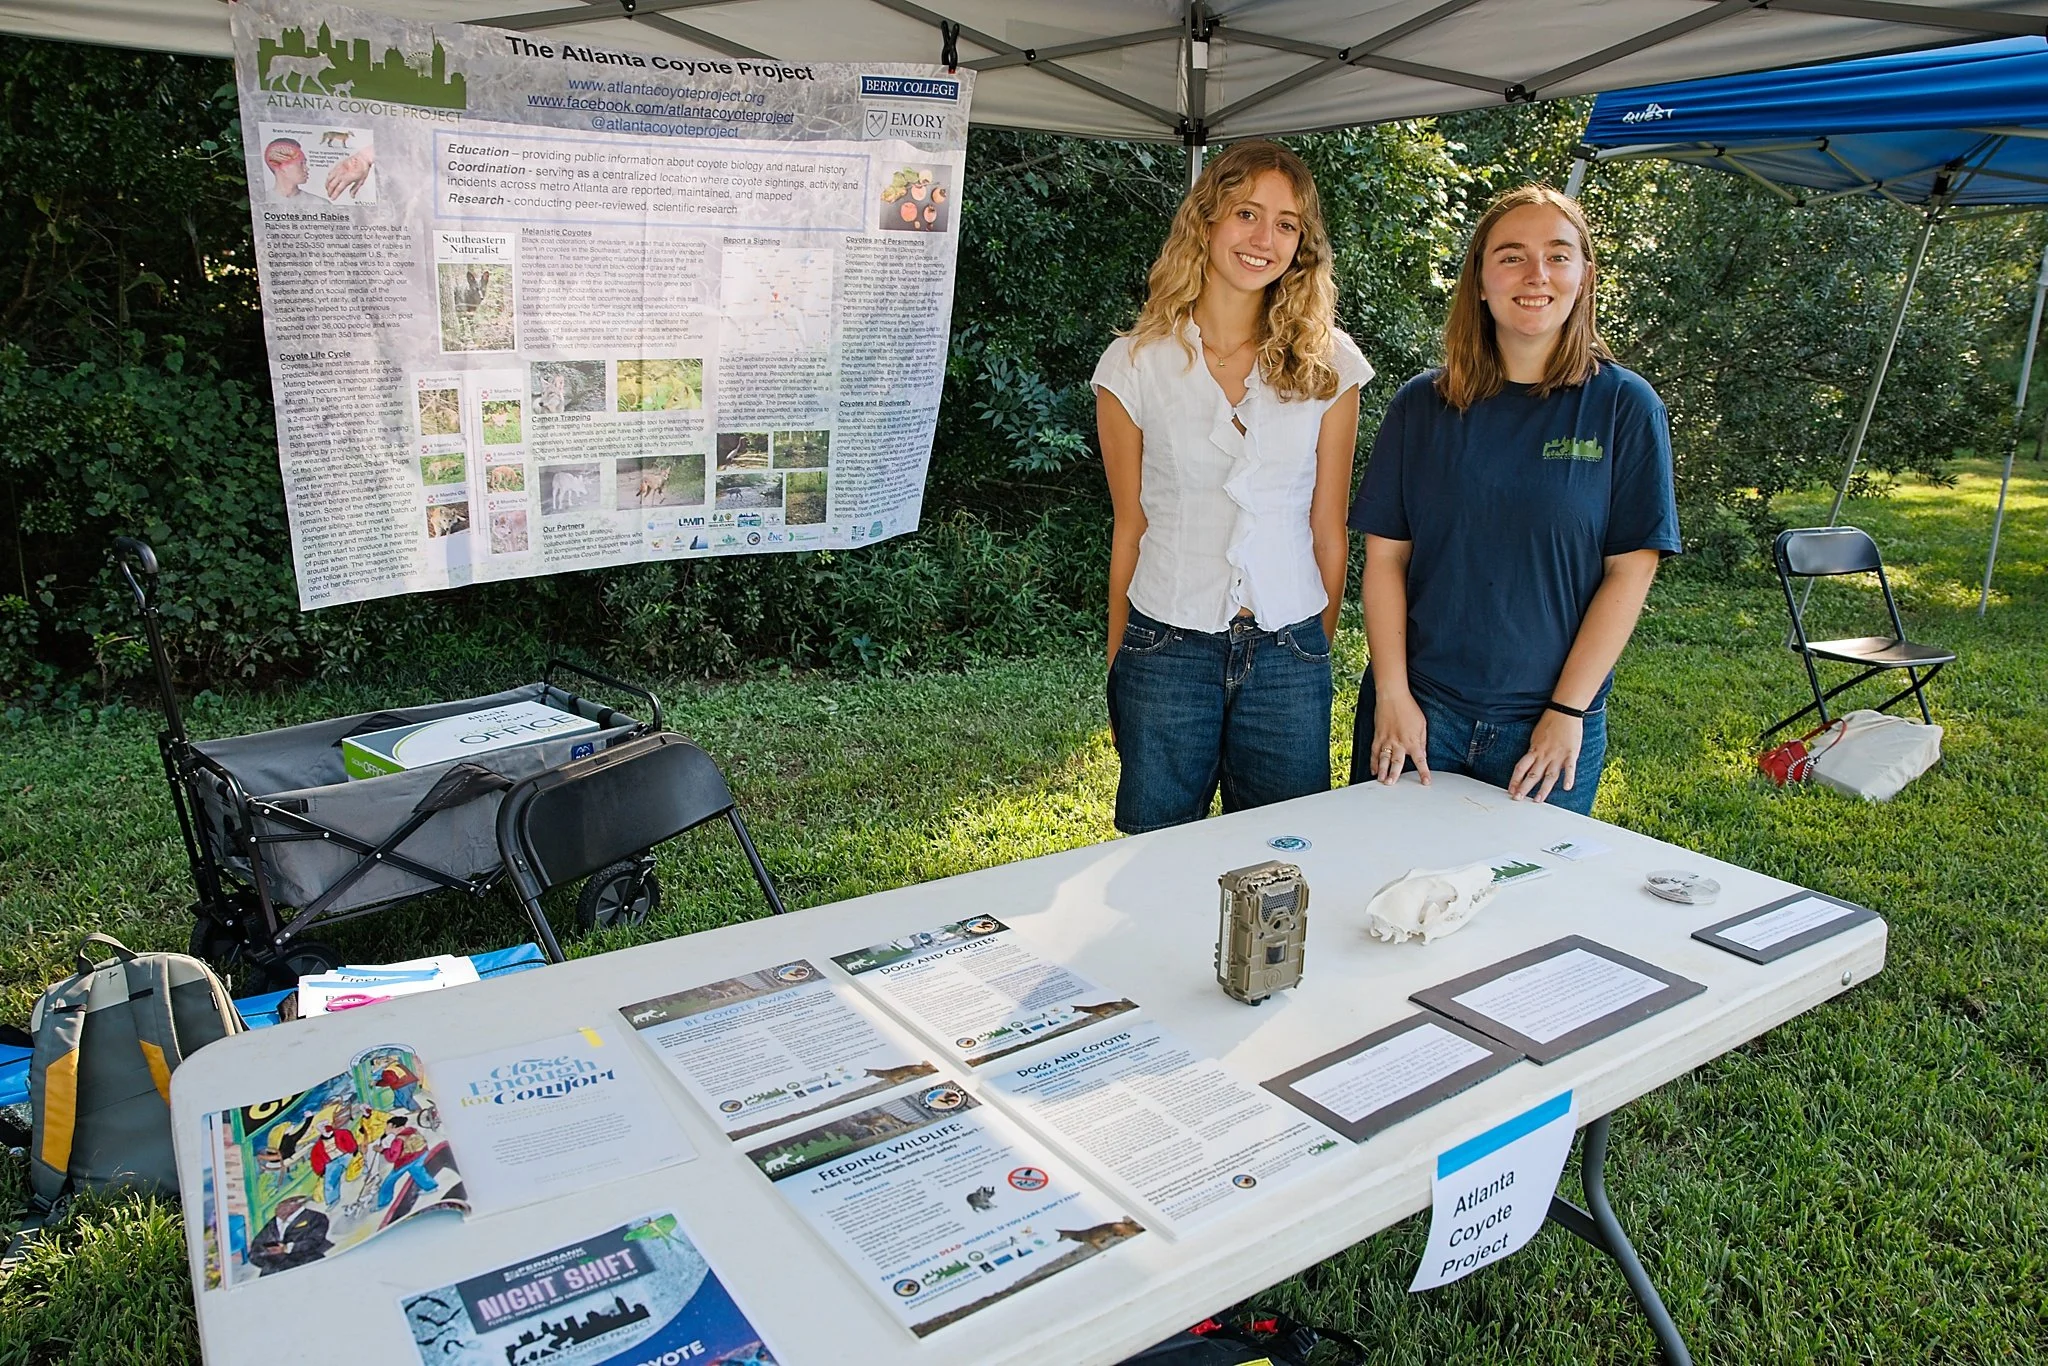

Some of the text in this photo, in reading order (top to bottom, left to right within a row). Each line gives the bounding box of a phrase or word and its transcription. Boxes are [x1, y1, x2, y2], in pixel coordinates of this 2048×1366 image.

[506, 36, 815, 82] The Atlanta Coyote Project
[567, 78, 765, 106] www.atlantacoyoteproject.org
[866, 79, 955, 96] BERRY COLLEGE
[267, 94, 463, 123] ATLANTA COYOTE PROJECT
[527, 94, 795, 125] www.facebook.com/atlantacoyoteproject
[891, 112, 945, 129] EMORY
[1622, 108, 1676, 124] QUEST
[591, 116, 739, 138] @atlantacoyoteproject
[889, 128, 943, 140] UNIVERSITY
[447, 143, 509, 157] Education
[522, 150, 571, 163] providing
[574, 152, 606, 164] public
[608, 154, 664, 167] information
[667, 156, 694, 168] about
[697, 160, 728, 171] coyote
[731, 160, 763, 172] biology
[766, 162, 783, 172] and
[786, 163, 815, 173] natural
[818, 164, 847, 176] history
[447, 176, 793, 202] incidents across metro Atlanta are reported, maintained, and mapped
[448, 161, 525, 175] Coordination
[535, 167, 574, 179] serving
[577, 170, 590, 178] as
[593, 171, 599, 179] a
[602, 169, 657, 181] centralized
[660, 173, 697, 183] location
[700, 175, 729, 185] where
[731, 177, 762, 188] coyote
[765, 177, 807, 190] sightings,
[809, 179, 840, 191] activity,
[843, 180, 859, 190] and
[448, 193, 504, 205] Research
[514, 196, 572, 210] conducting
[653, 202, 695, 213] scientific
[264, 212, 350, 222] Coyotes and Rabies
[300, 223, 334, 232] extremely
[442, 234, 506, 245] Southeastern
[522, 228, 592, 237] Melanistic Coyotes
[723, 237, 745, 246] Report
[753, 237, 781, 246] Sighting
[846, 236, 871, 245] Coyotes
[887, 238, 925, 246] Persimmons
[450, 244, 499, 254] Naturalist
[279, 350, 351, 361] Coyote Life Cycle
[839, 400, 864, 408] Coyotes
[878, 399, 911, 408] Biodiversity
[531, 413, 591, 424] Camera Trapping
[543, 522, 584, 533] Our Partners
[460, 714, 577, 744] OFFICE
[880, 936, 999, 975] DOGS AND COYOTES:
[684, 991, 800, 1027] BE COYOTE AWARE
[490, 1055, 569, 1079] Close
[1017, 1032, 1132, 1078] DOGS AND COYOTES
[1034, 1068, 1058, 1079] WHAT
[1059, 1062, 1076, 1071] YOU
[1077, 1054, 1096, 1064] NEED
[460, 1095, 492, 1107] for
[494, 1069, 615, 1105] Comfort
[469, 1058, 597, 1096] Enough
[811, 1186, 824, 1194] It's
[825, 1179, 842, 1190] hard
[852, 1168, 872, 1179] resist
[873, 1158, 900, 1172] feeding
[902, 1149, 926, 1161] wildlife
[926, 1143, 937, 1151] but
[939, 1134, 961, 1147] please
[818, 1152, 887, 1181] FEEDING
[887, 1123, 964, 1154] WILDLIFE:
[853, 1179, 864, 1187] for
[865, 1172, 882, 1182] their
[883, 1163, 906, 1175] health
[907, 1157, 921, 1167] and
[921, 1152, 936, 1162] your
[1454, 1170, 1515, 1218] Atlanta
[1449, 1204, 1512, 1247] Coyote
[518, 1247, 585, 1273] FERNBANK
[939, 1244, 962, 1257] DEAD
[1440, 1232, 1508, 1278] Project
[477, 1276, 558, 1321] NIGHT
[563, 1248, 636, 1290] SHIFT
[566, 1320, 651, 1355] COYOTE PROJECT
